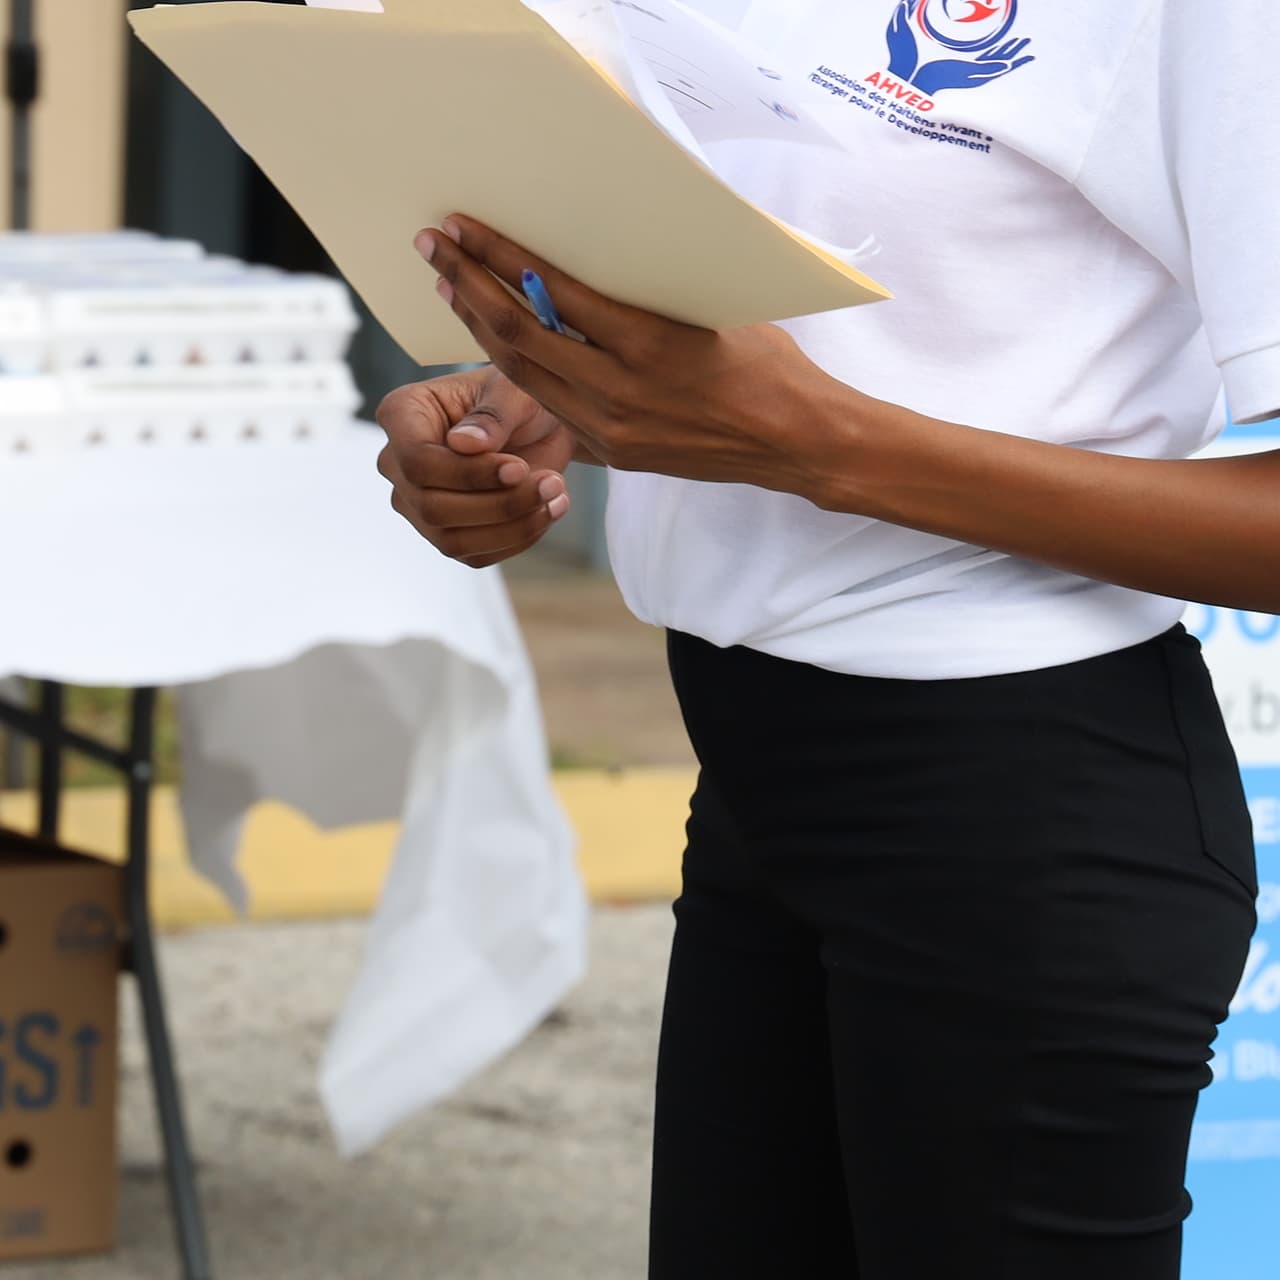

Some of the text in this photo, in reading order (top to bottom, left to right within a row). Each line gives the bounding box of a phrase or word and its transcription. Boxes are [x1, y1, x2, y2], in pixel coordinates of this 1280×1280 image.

[817, 64, 867, 95] Association
[868, 91, 887, 105] des
[940, 122, 983, 139] vivant
[864, 71, 935, 112] AHVED
[848, 95, 875, 111] pour
[875, 107, 887, 118] le
[887, 113, 992, 154] Developpement
